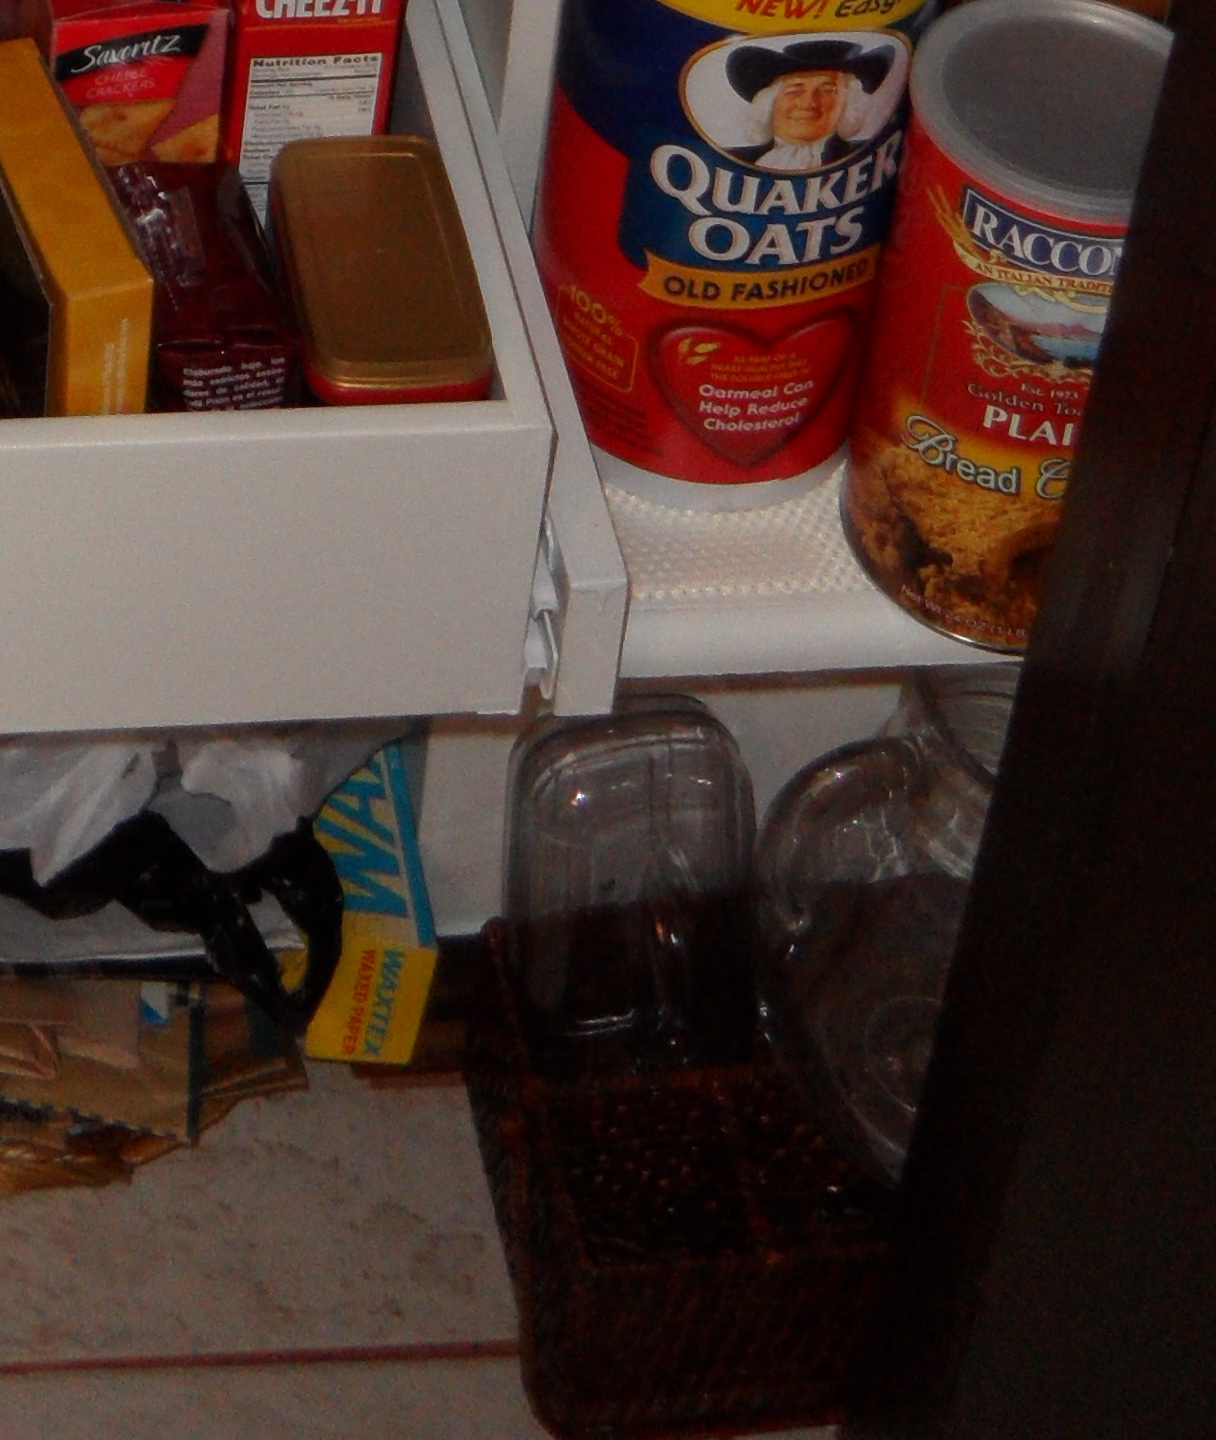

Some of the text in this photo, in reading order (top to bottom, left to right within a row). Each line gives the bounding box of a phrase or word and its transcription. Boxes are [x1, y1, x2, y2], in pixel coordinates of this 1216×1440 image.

[71, 34, 182, 74] Savoritz
[253, 55, 379, 67] Nutrition Facts
[86, 79, 156, 99] CRACKERS
[95, 70, 147, 85] CHEESE
[650, 130, 904, 214] QUAKER
[687, 204, 867, 268] OATS
[663, 259, 868, 303] OLD FASHIONED
[974, 262, 1053, 288] AN ITALIAN
[568, 284, 625, 337] 100%
[699, 379, 814, 401] Oatmeal Can
[699, 396, 808, 418] Help Reduce
[967, 383, 1045, 412] Golden
[1020, 382, 1043, 397] Est.
[703, 412, 801, 432] Cholesterol
[982, 404, 1075, 447] PLAI
[901, 414, 1071, 500] Bread C
[314, 760, 408, 917] WA
[341, 948, 377, 1056] WAXED PAPER
[363, 948, 406, 1056] WAXTEX
